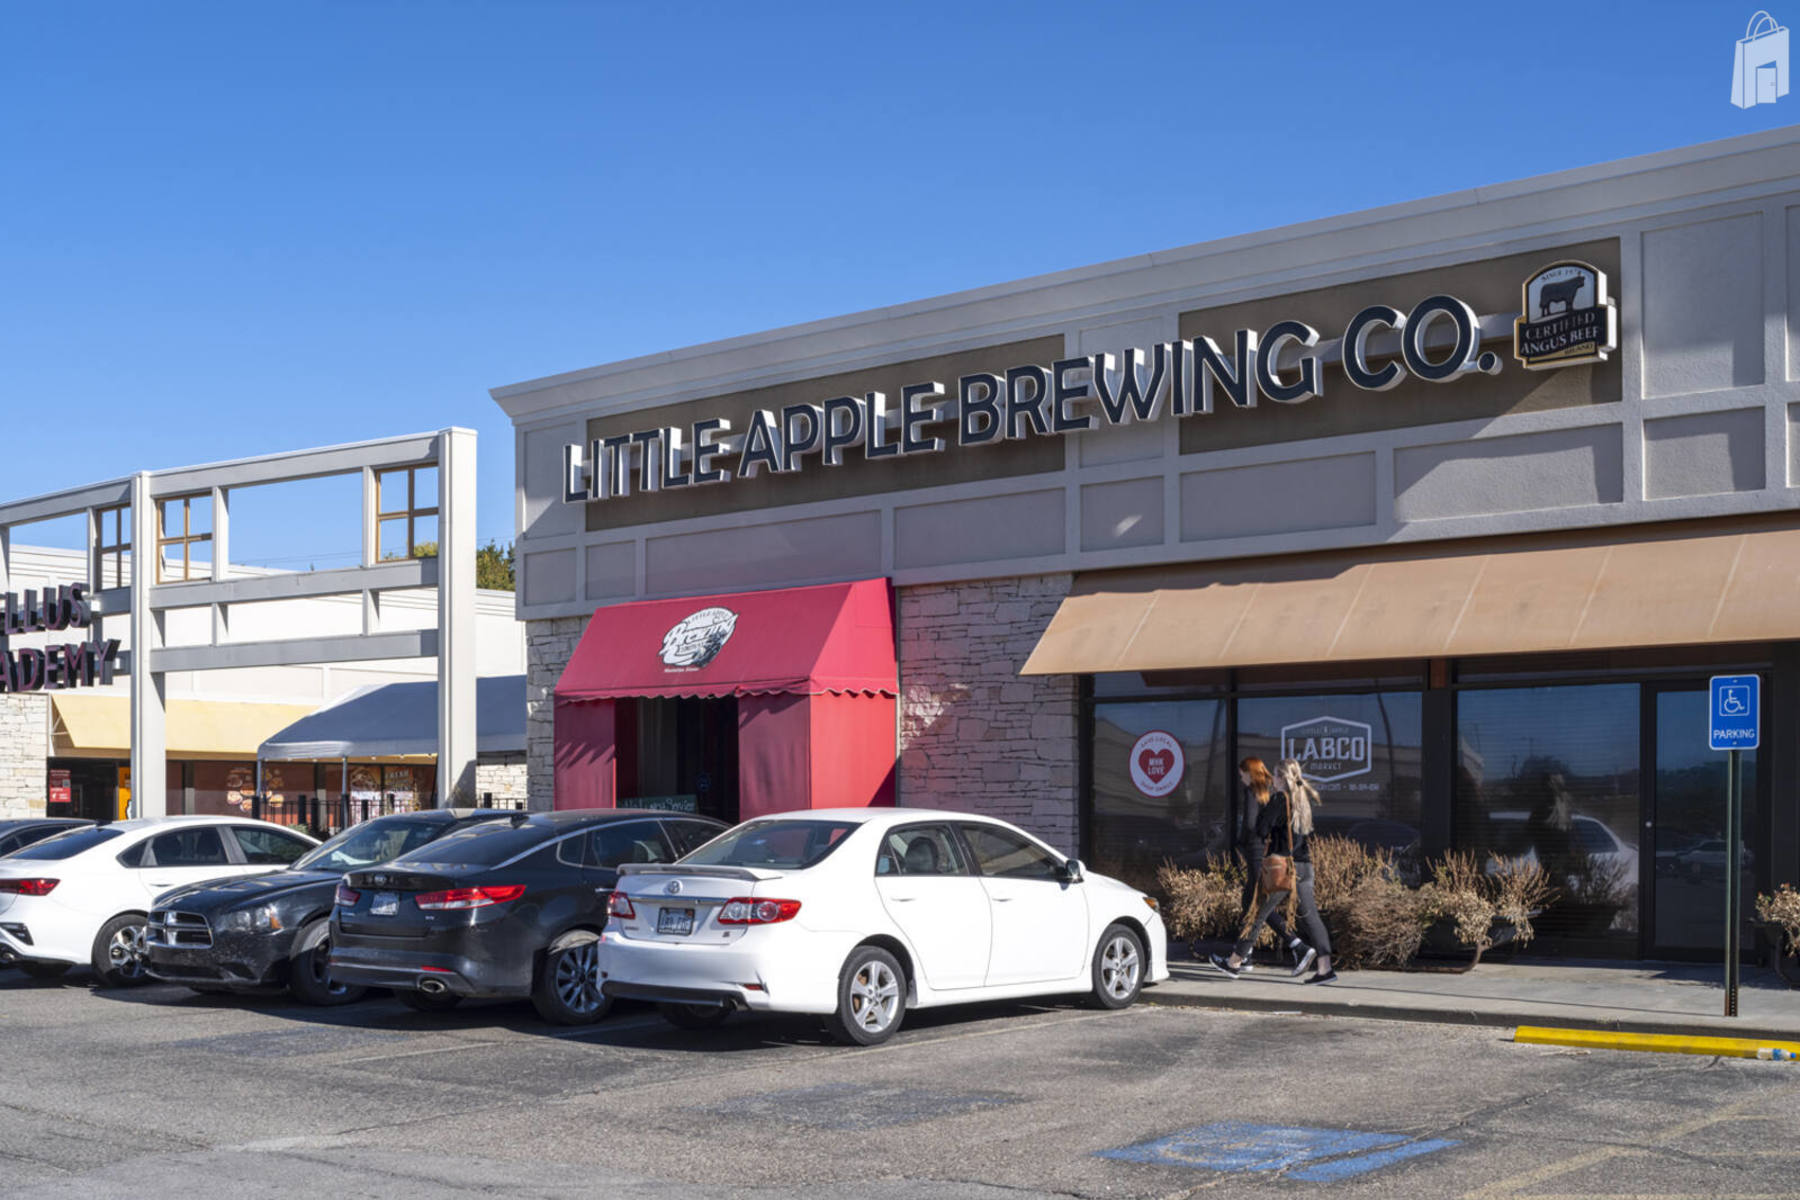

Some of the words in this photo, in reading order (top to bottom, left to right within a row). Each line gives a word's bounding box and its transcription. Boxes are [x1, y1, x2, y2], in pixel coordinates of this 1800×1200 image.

[1521, 334, 1567, 354] ANGUS
[1570, 326, 1600, 343] BEEF
[1525, 312, 1596, 340] CERTIFIED
[563, 417, 731, 504] LITTLE
[737, 381, 945, 479] APPLE
[958, 320, 1324, 446] BREWING
[1342, 295, 1504, 391] CO.
[0, 582, 92, 635] LLUS
[1713, 729, 1755, 739] PARKING
[1287, 737, 1365, 760] LABCO
